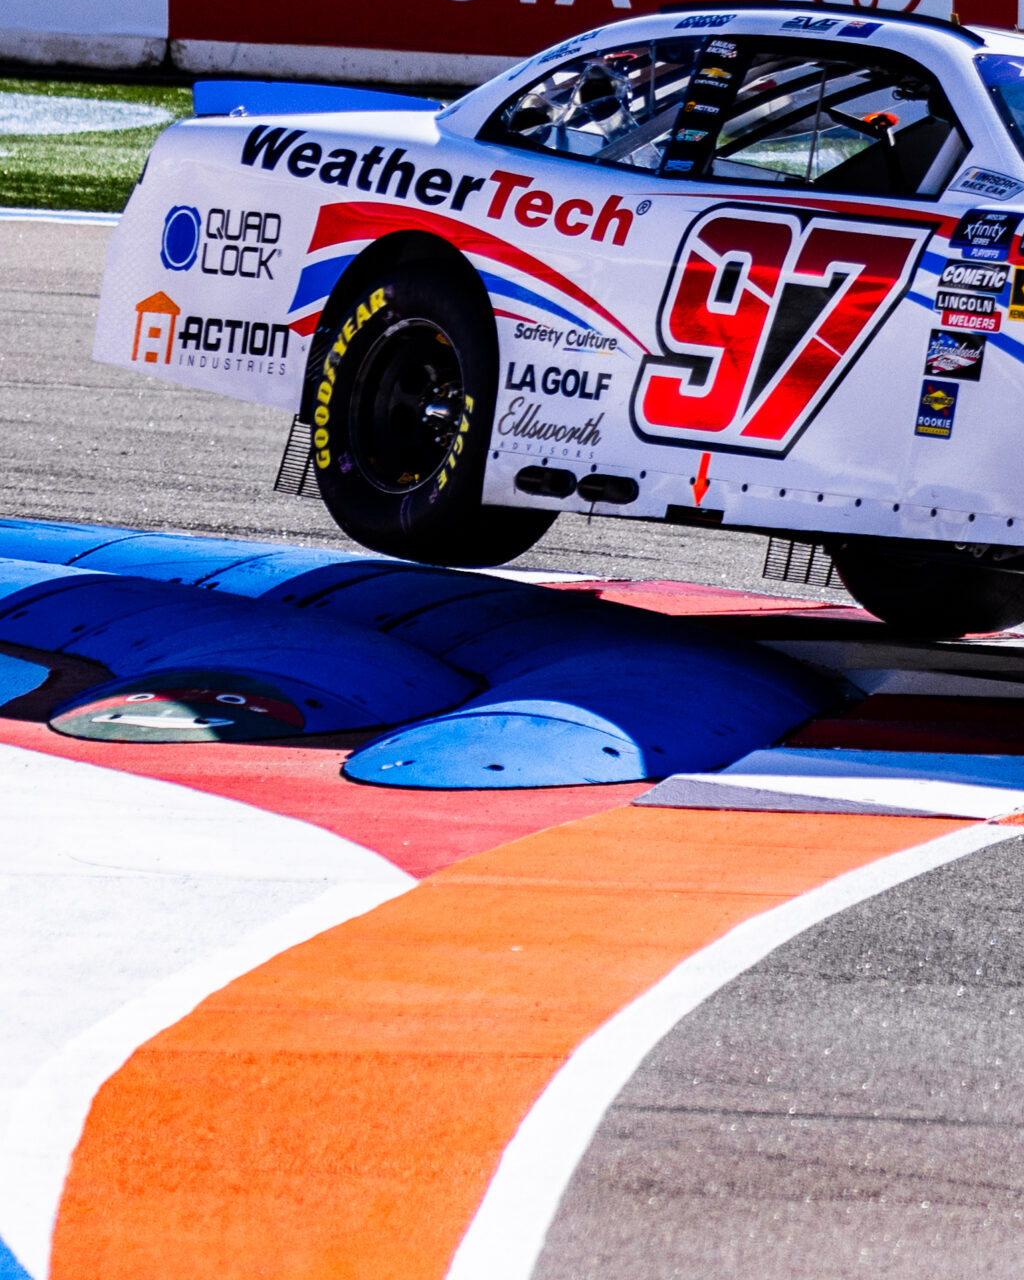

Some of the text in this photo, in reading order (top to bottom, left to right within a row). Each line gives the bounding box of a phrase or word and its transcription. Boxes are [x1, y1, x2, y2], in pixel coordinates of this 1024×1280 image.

[240, 124, 639, 247] WeatherTech
[960, 180, 1007, 196] RACE CAR
[206, 208, 282, 244] QUAD
[963, 220, 1008, 242] xfinity
[201, 243, 278, 280] LOCK
[971, 248, 999, 259] PLAYOFFS
[942, 267, 1007, 288] COMETIC
[937, 294, 994, 313] LINCOLN
[514, 322, 618, 351] Safety Culture
[630, 202, 940, 458] 97
[948, 314, 997, 330] WELDERS
[178, 316, 290, 359] ACTION
[178, 354, 287, 376] INDUSTRIES
[314, 287, 388, 470] GOODYEAR
[505, 361, 613, 401] LA GOLF
[497, 396, 606, 447] Ellsworth
[917, 416, 952, 429] ROOKIE
[436, 394, 475, 491] EAGLE
[500, 440, 595, 460] ADVISORS
